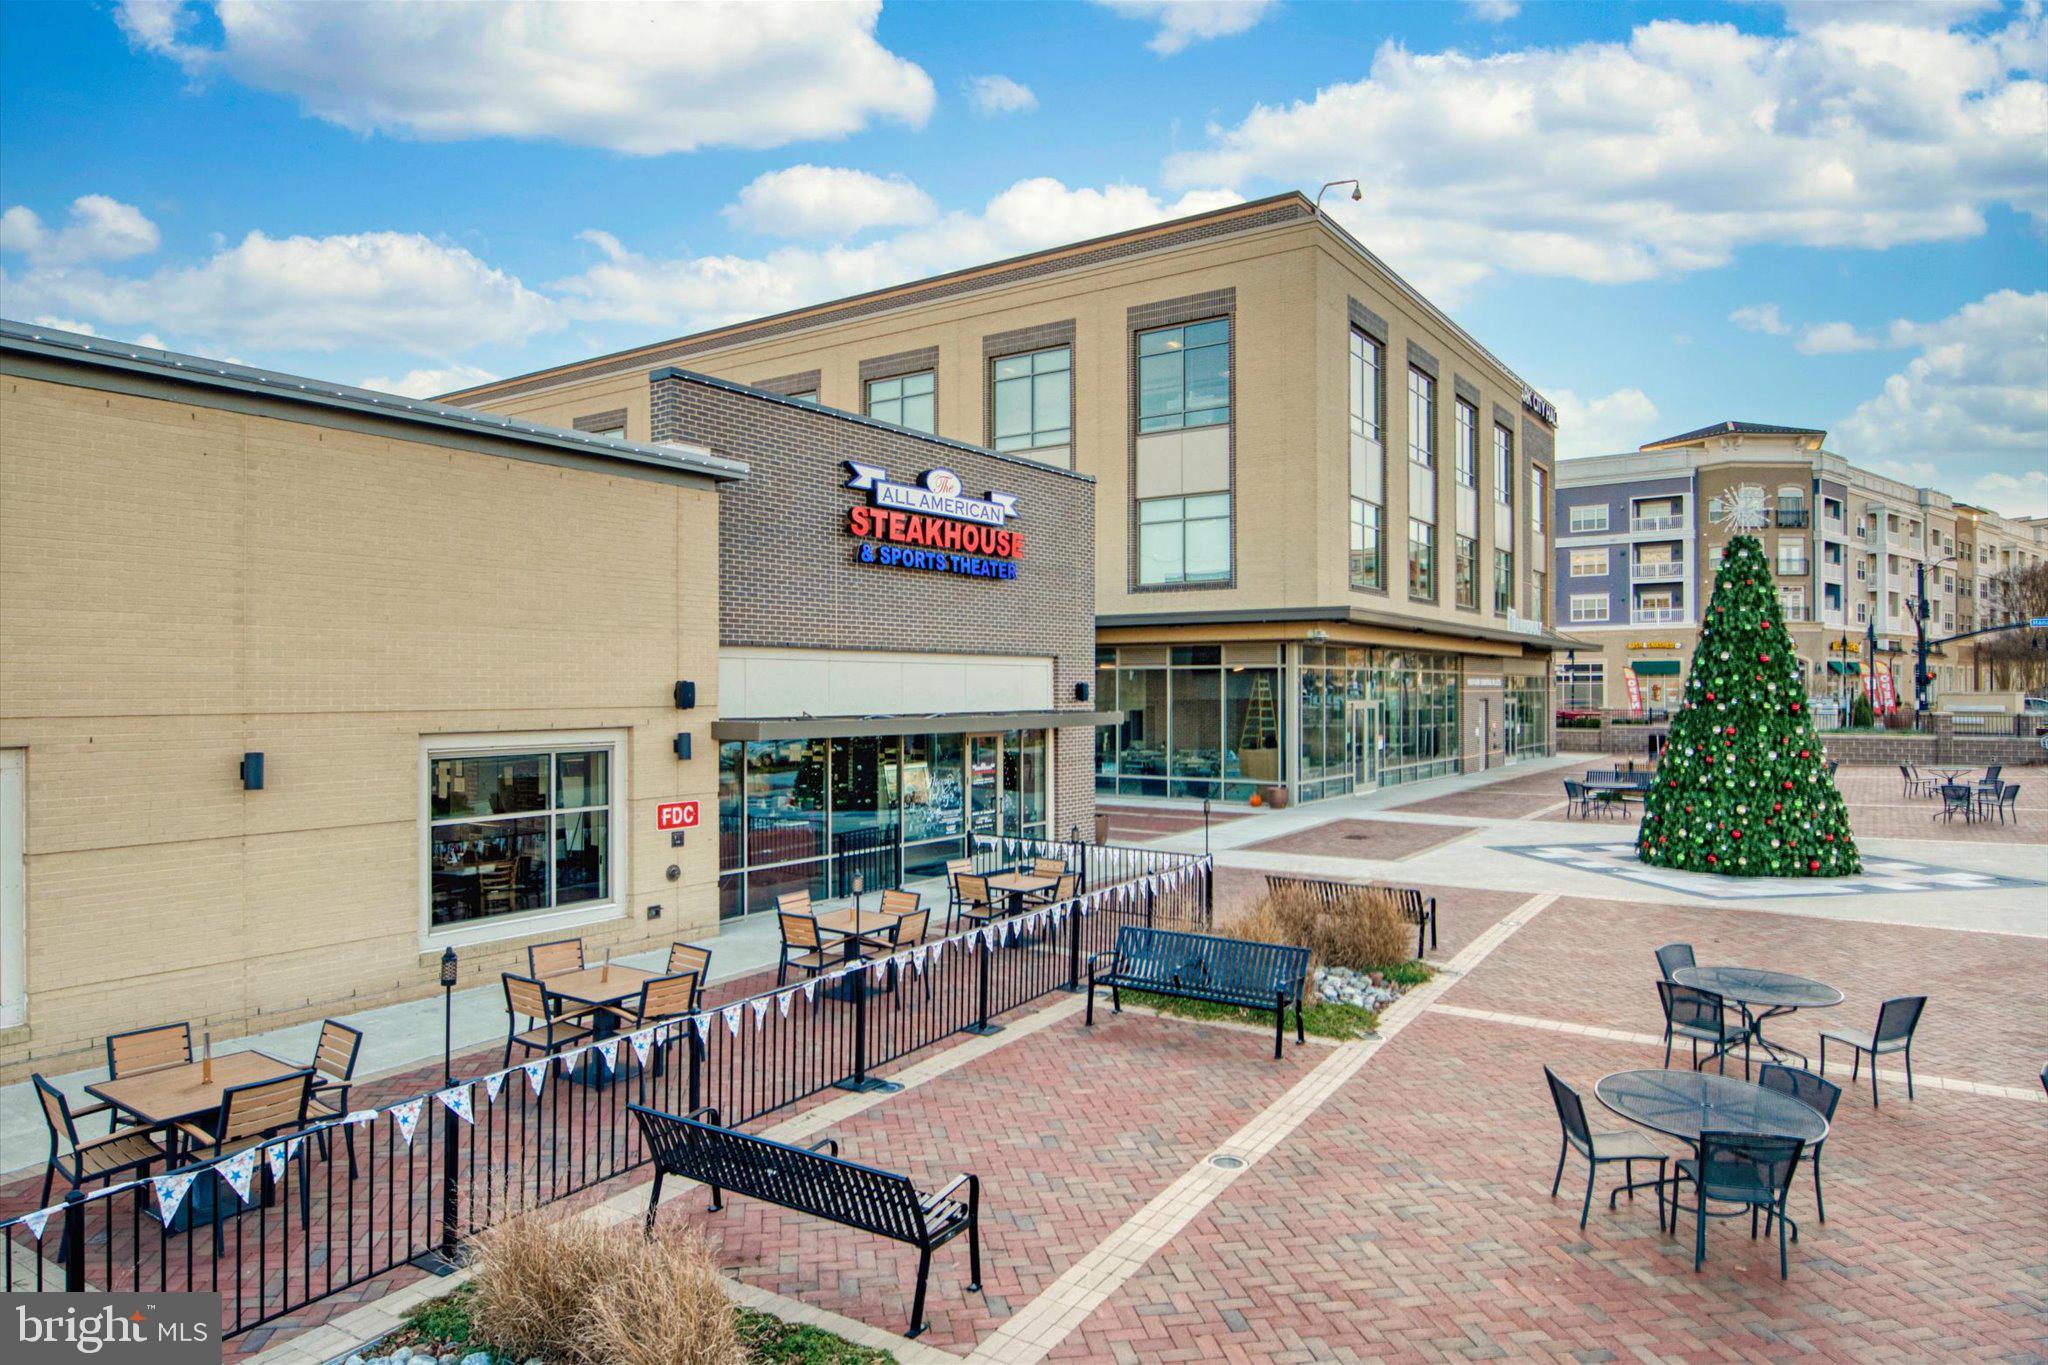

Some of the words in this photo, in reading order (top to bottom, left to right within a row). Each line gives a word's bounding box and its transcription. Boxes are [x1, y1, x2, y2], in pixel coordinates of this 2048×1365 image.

[933, 474, 954, 494] The
[882, 487, 915, 507] ALL
[919, 494, 1001, 522] AMERICAN
[850, 506, 1024, 558] STEAKHOUSE
[861, 543, 874, 563] &
[880, 545, 947, 571] SPORTS
[950, 555, 1017, 580] THEATER
[662, 805, 694, 826] FDC
